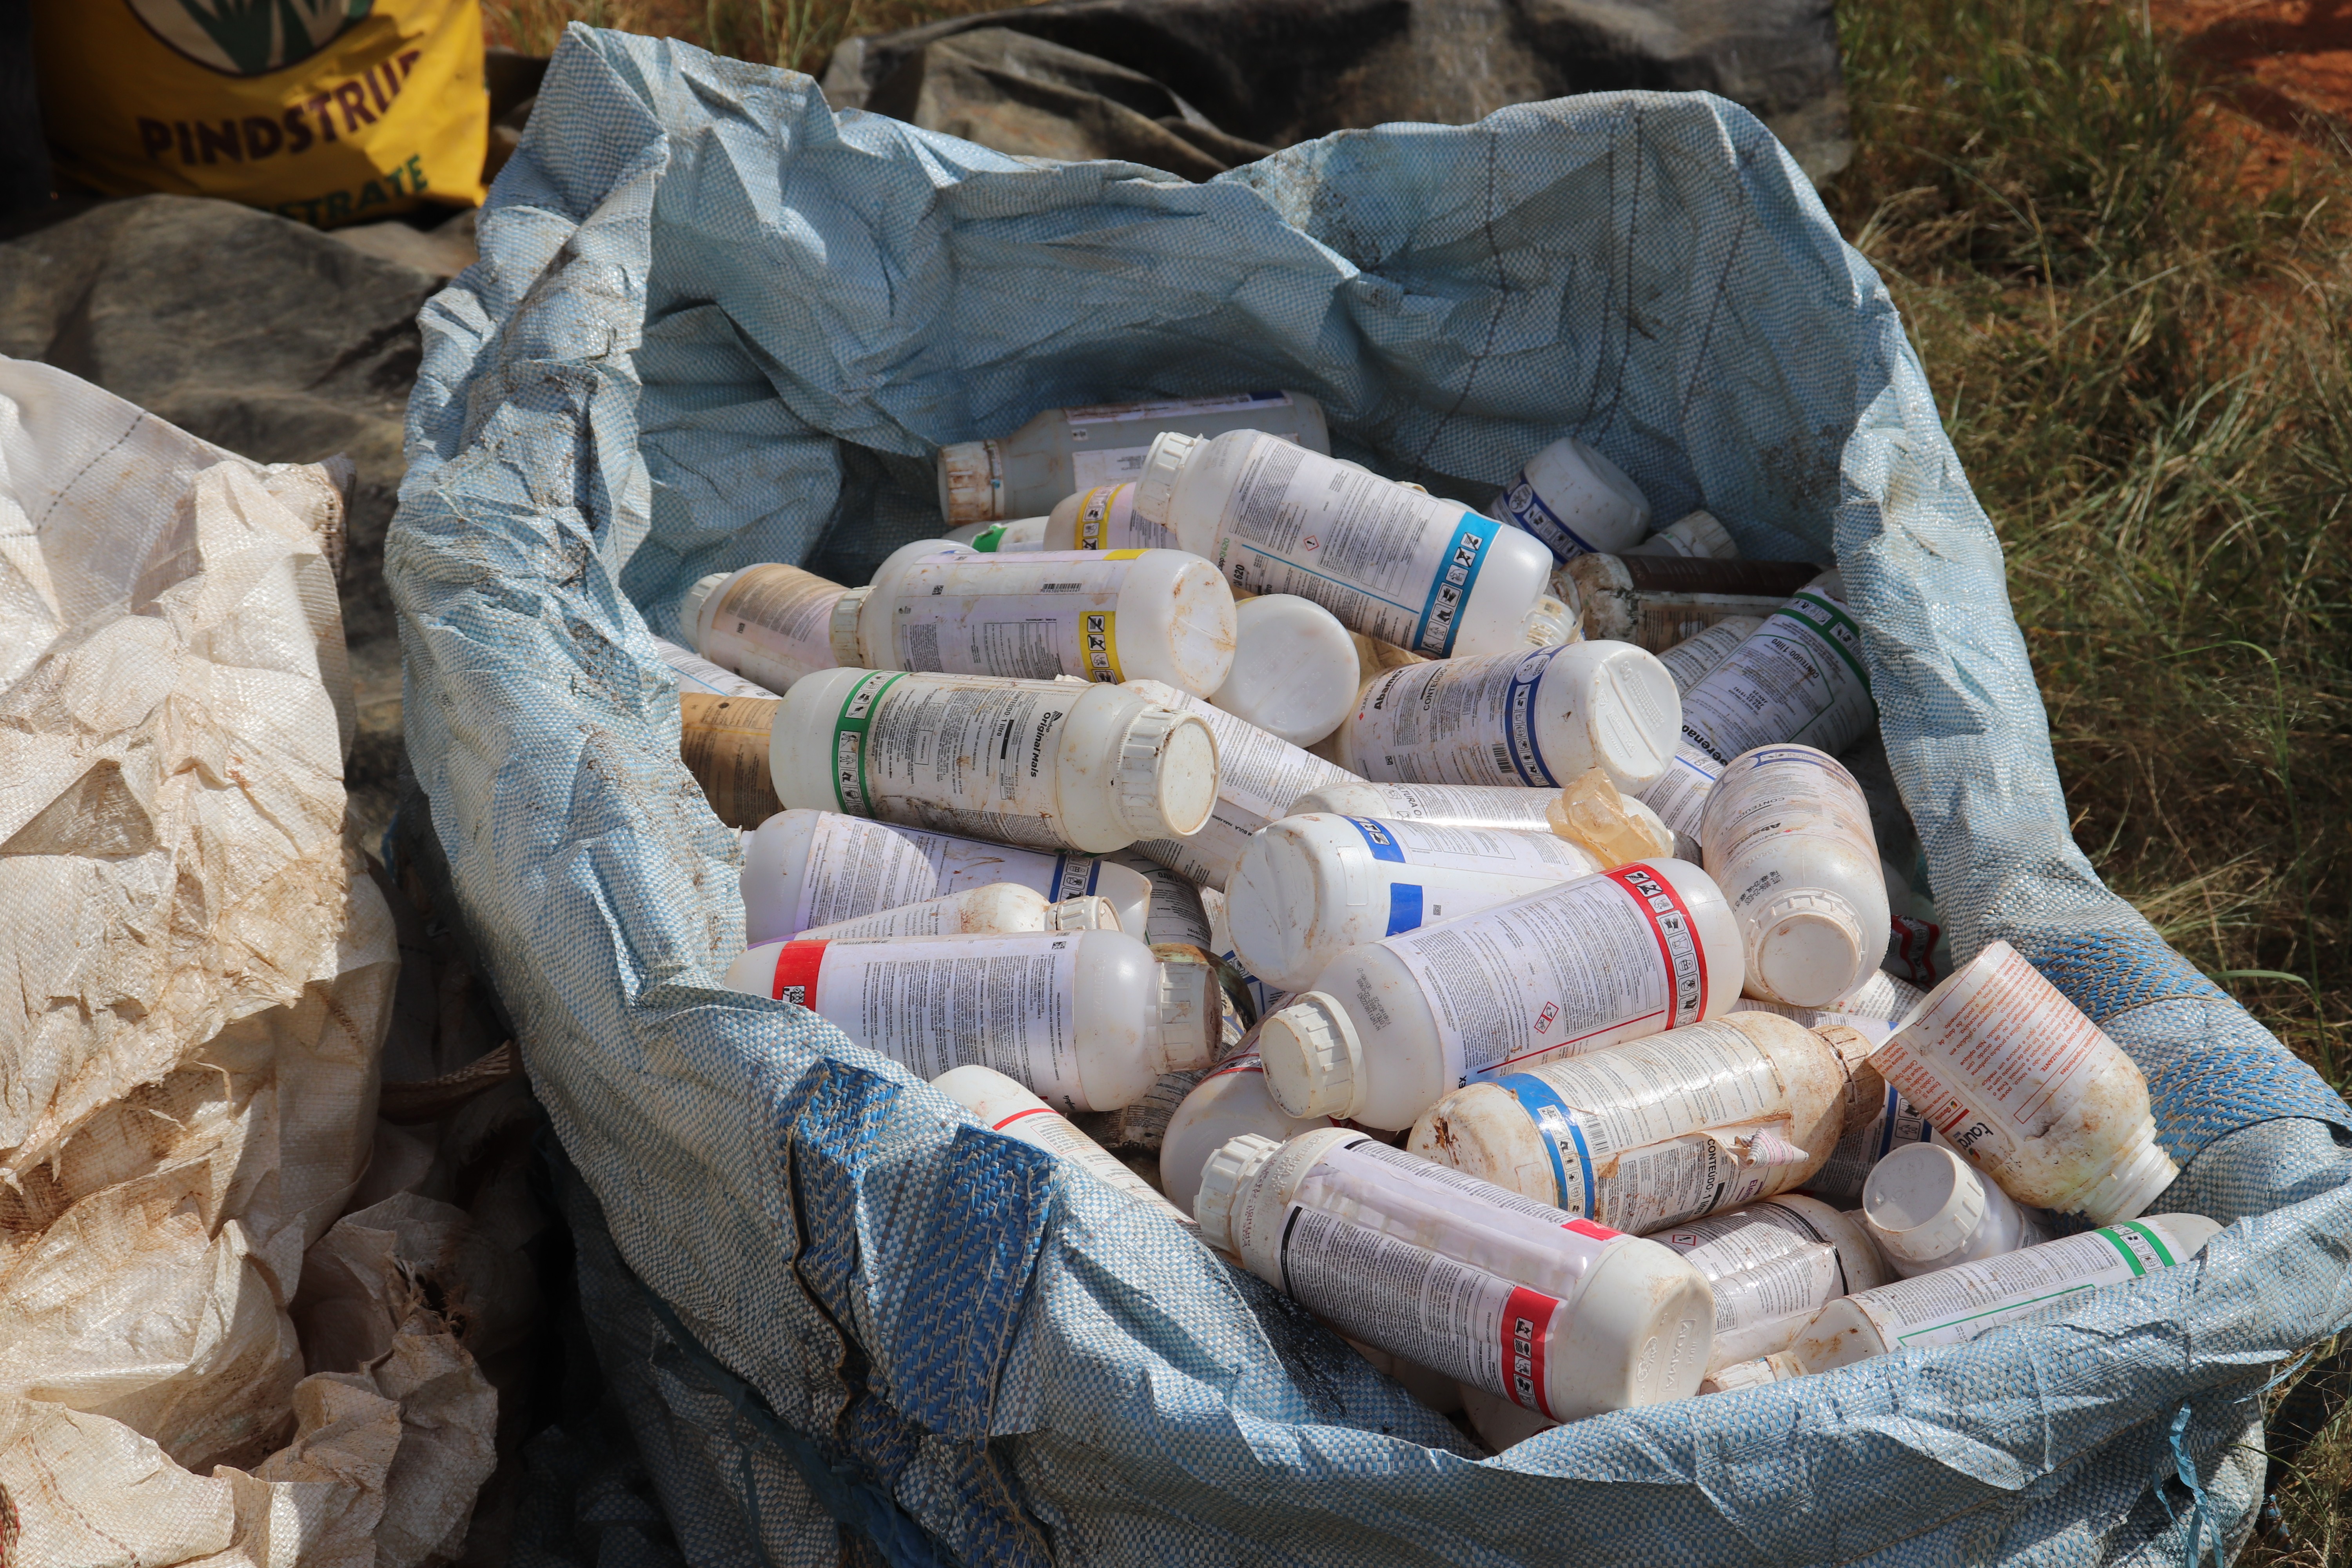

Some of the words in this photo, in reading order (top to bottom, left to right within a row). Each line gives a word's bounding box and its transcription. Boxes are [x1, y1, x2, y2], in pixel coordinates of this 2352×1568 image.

[1233, 564, 1245, 580] 620
[1770, 637, 1786, 651] litro
[1532, 658, 1546, 676] CUIDADO
[1536, 658, 1549, 675] VENENO
[1787, 648, 1820, 679] CONTEÚDO:
[1002, 691, 1024, 717] CONTEÚDO:
[996, 723, 1005, 737] litro
[1044, 710, 1058, 733] Roundup
[1033, 711, 1051, 751] Original
[1030, 752, 1038, 778] Mais
[1234, 824, 1247, 835] BULA
[1527, 962, 1536, 975] PERIGO
[1980, 988, 1993, 1000] anos,
[1995, 976, 2024, 1008] Armazenamento:
[1942, 994, 1977, 1031] armazenamento.
[1962, 1007, 1976, 1021] partir
[1978, 996, 1996, 1016] umidade
[1998, 999, 2014, 1015] hídrico.
[2004, 995, 2026, 1020] profissional
[2007, 1000, 2031, 1025] embalagem
[2018, 998, 2043, 1025] Importantes:
[1958, 1013, 1980, 1036] excessiva.
[1975, 1006, 1998, 1029] Conservar
[1944, 1027, 1956, 1040] data
[1985, 1016, 2008, 1040] habilitado.
[2008, 1022, 2023, 1037] Utilize
[1955, 1030, 1974, 1050] produto
[2065, 1031, 2078, 1045] COMO
[1888, 1045, 1904, 1060] Natureza
[1948, 1047, 1957, 1056] em
[1976, 1042, 1993, 1060] acordo
[1988, 1038, 2007, 1057] produto
[2004, 1042, 2022, 1062] procure
[2021, 1042, 2033, 1055] caso
[2027, 1039, 2046, 1059] crianças
[2039, 1039, 2056, 1058] produto
[1959, 1047, 1978, 1067] aplique
[1965, 1060, 1976, 1072] com
[1970, 1054, 1991, 1077] conforme
[2031, 1056, 2042, 1067] não
[2038, 1042, 2068, 1074] FERTILIZANTE.
[2058, 1046, 2085, 1076] Importantes
[1901, 1059, 1919, 1074] Carbono
[2000, 1059, 2018, 1077] contato
[2007, 1061, 2027, 1082] animais.
[1909, 1069, 1930, 1089] Molibdênio
[1918, 1074, 1936, 1091] Cobalto
[1925, 1080, 1942, 1095] Enxofre
[1980, 1069, 1999, 1088] médico
[1992, 1074, 2003, 1086] com
[1996, 1080, 2009, 1093] Evite
[2011, 1071, 2029, 1087] tóxico,
[1931, 1089, 1950, 1106] Nutrientes
[1996, 1085, 2013, 1103] porém
[1933, 1105, 1952, 1122] Garantias
[1956, 1121, 1993, 1150] taura
[1704, 1139, 1718, 1194] CONTEÚDO:
[1693, 1200, 1710, 1215] litro
[1665, 1321, 1690, 1389] ADAMA
